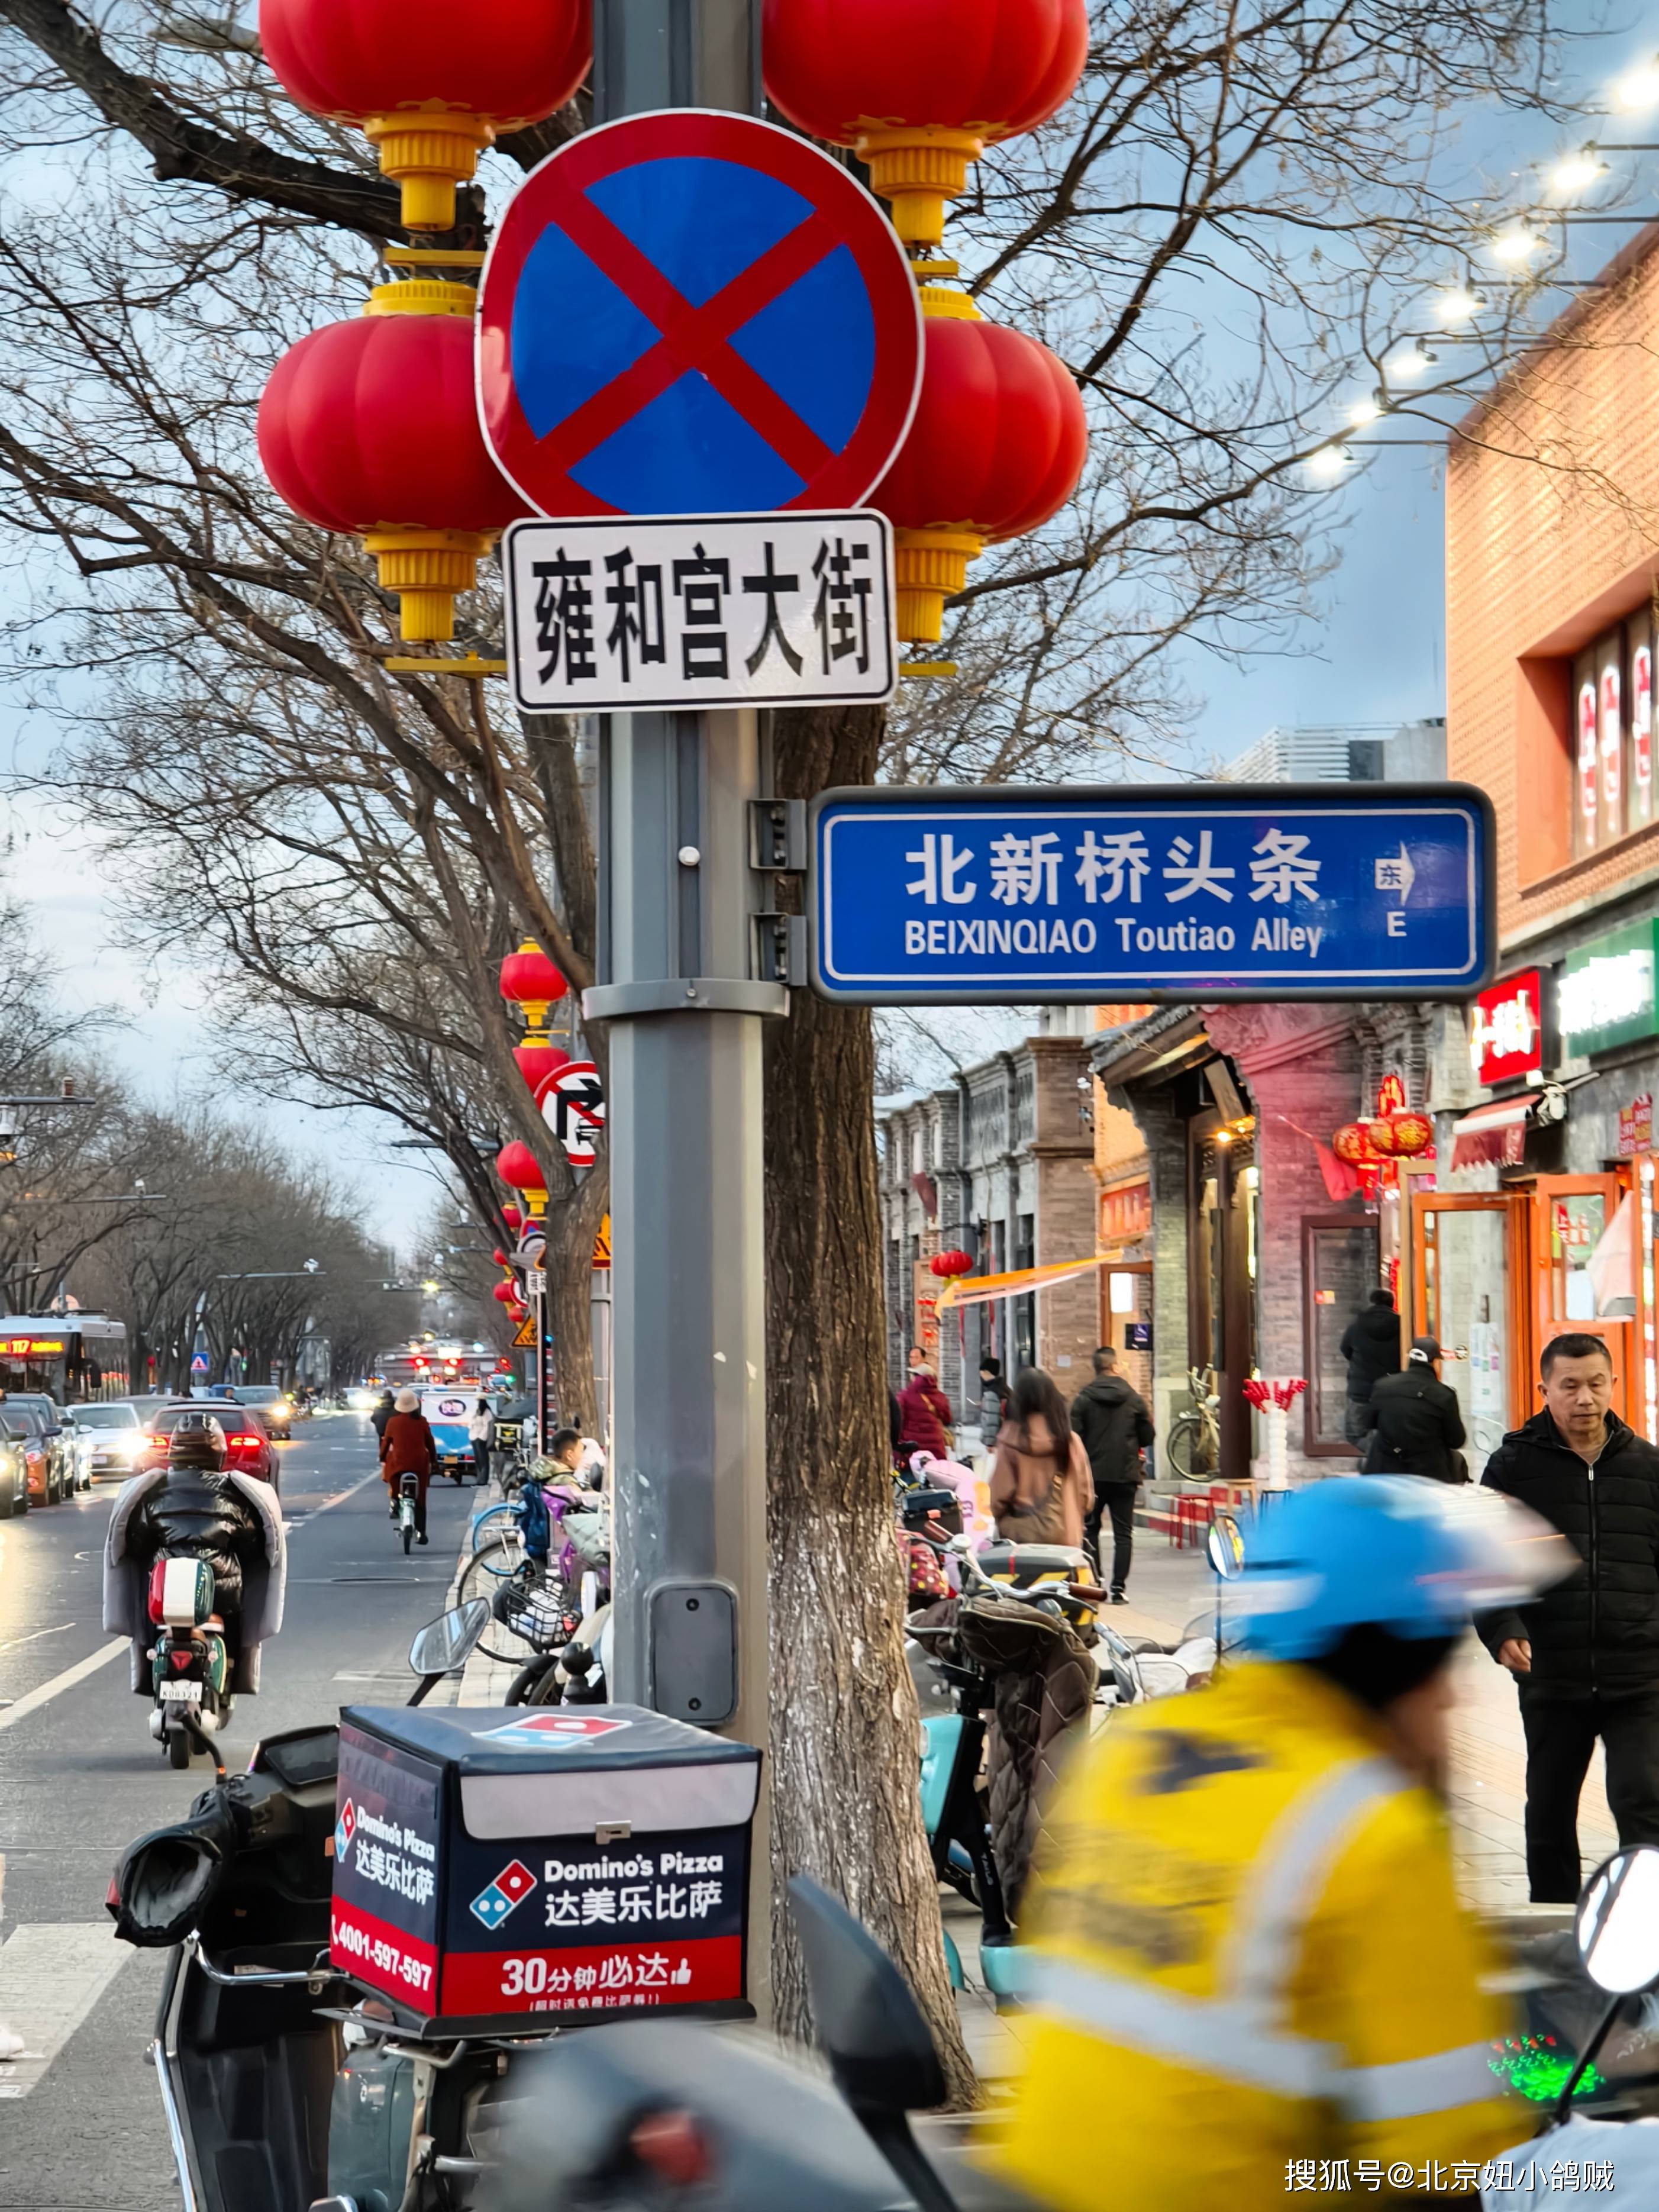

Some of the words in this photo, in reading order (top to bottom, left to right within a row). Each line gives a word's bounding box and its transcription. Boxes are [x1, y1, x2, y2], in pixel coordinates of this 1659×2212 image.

[532, 537, 872, 685] 雍和宫大街
[905, 828, 1322, 905] 北新桥头条
[1380, 865, 1401, 886] 东
[905, 918, 1096, 955] BEIXINQIAO
[1115, 917, 1235, 952] Toutiao
[1251, 917, 1322, 958] Alley
[1387, 911, 1407, 937] E
[357, 1805, 402, 1847] Domino's
[404, 1828, 435, 1862] Pizza
[356, 1839, 434, 1905] 达美乐比萨
[544, 1854, 654, 1882] Domino's
[660, 1851, 723, 1875] Pizza
[544, 1881, 722, 1927] 达美乐比萨
[338, 1922, 432, 1991] 4001-597-597
[501, 1952, 669, 1995] 30分钟必达
